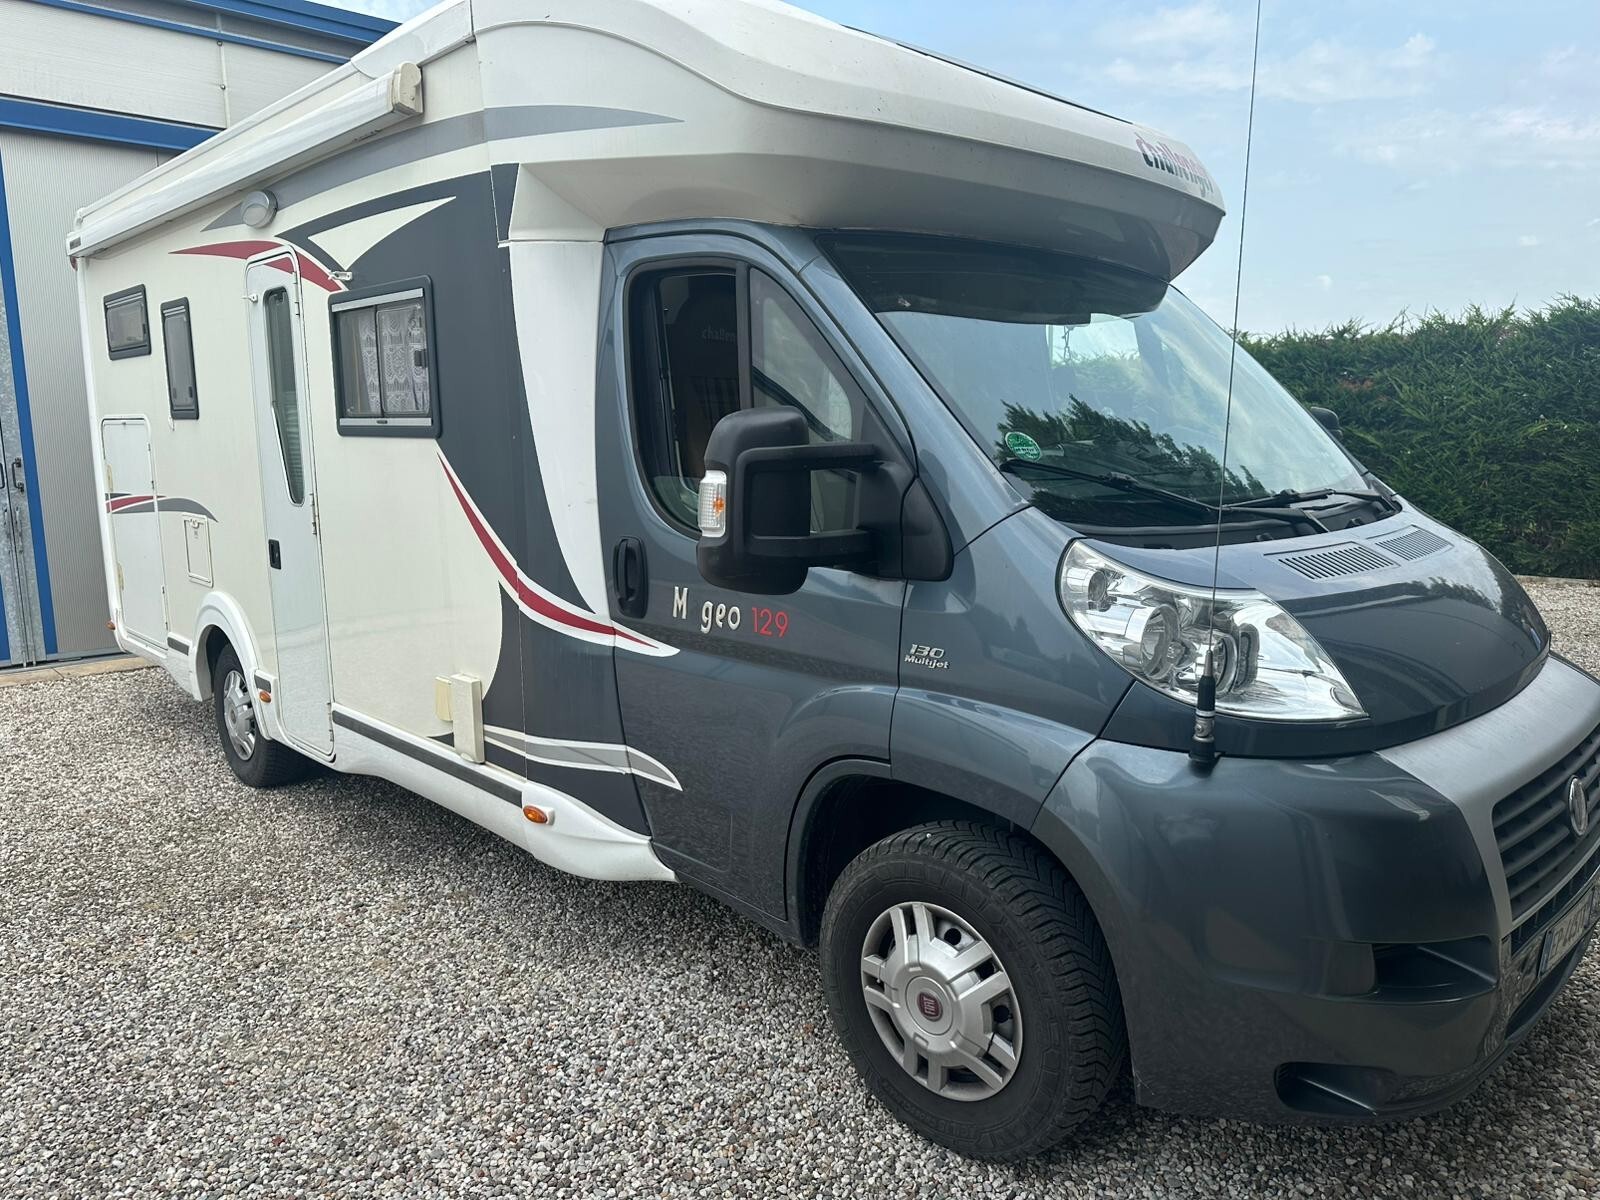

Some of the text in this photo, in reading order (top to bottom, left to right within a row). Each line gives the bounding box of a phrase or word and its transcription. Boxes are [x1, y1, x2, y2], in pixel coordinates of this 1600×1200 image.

[673, 586, 789, 638] M geo 129
[910, 643, 945, 659] 130
[904, 655, 950, 669] Multijet
